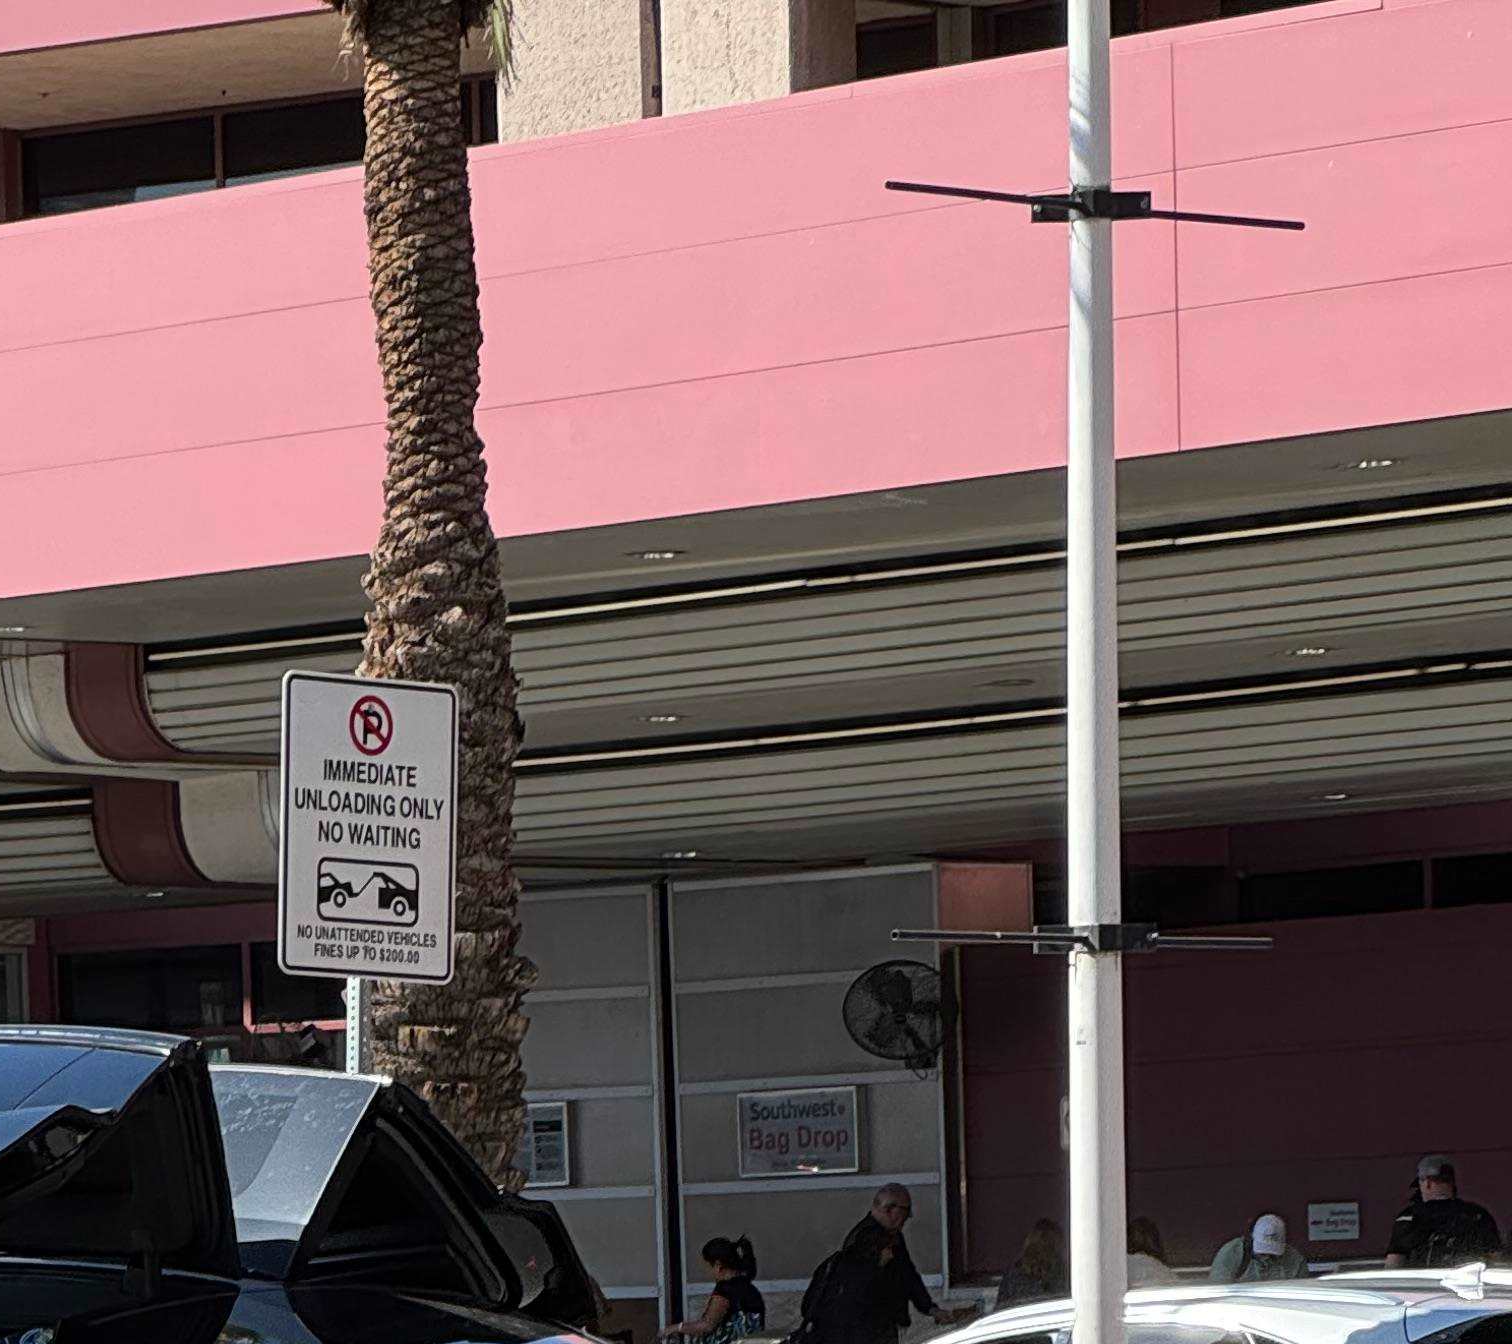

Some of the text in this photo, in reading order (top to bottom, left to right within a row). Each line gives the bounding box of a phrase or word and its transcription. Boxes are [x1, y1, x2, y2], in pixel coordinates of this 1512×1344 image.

[323, 758, 417, 788] IMMEDIATE
[294, 786, 444, 821] UNLOADING ONLY
[318, 819, 421, 849] NO WAITING
[297, 924, 438, 948] NO UNATTENDED VEHICLES
[314, 942, 420, 964] FINES UP TO $200.00
[750, 1099, 838, 1121] Southwest
[749, 1125, 849, 1155] Bag Drop
